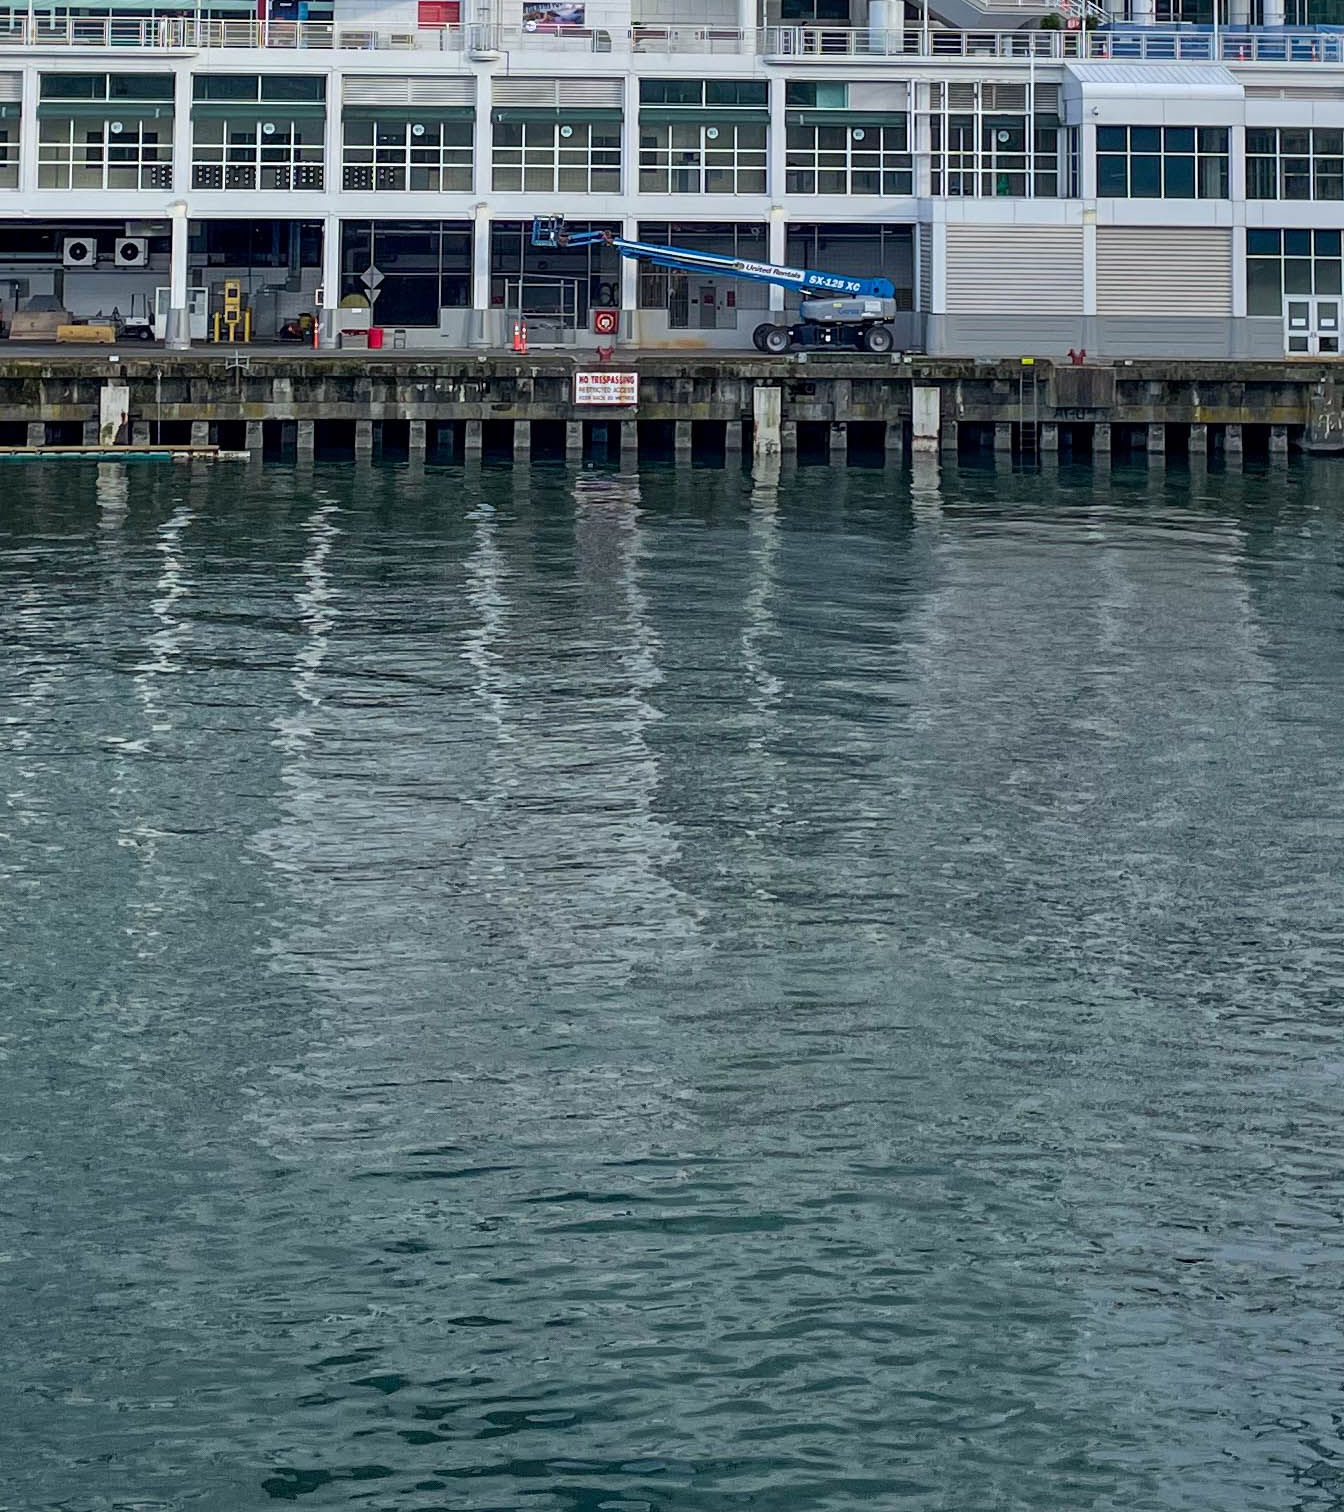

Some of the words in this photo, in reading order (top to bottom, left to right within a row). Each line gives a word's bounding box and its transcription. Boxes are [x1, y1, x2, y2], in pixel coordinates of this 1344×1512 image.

[746, 264, 773, 274] United
[773, 268, 801, 279] Rentals
[809, 275, 845, 289] SX-125
[845, 281, 861, 292] XC
[579, 375, 589, 384] NO
[591, 375, 635, 384] TRESPASSING
